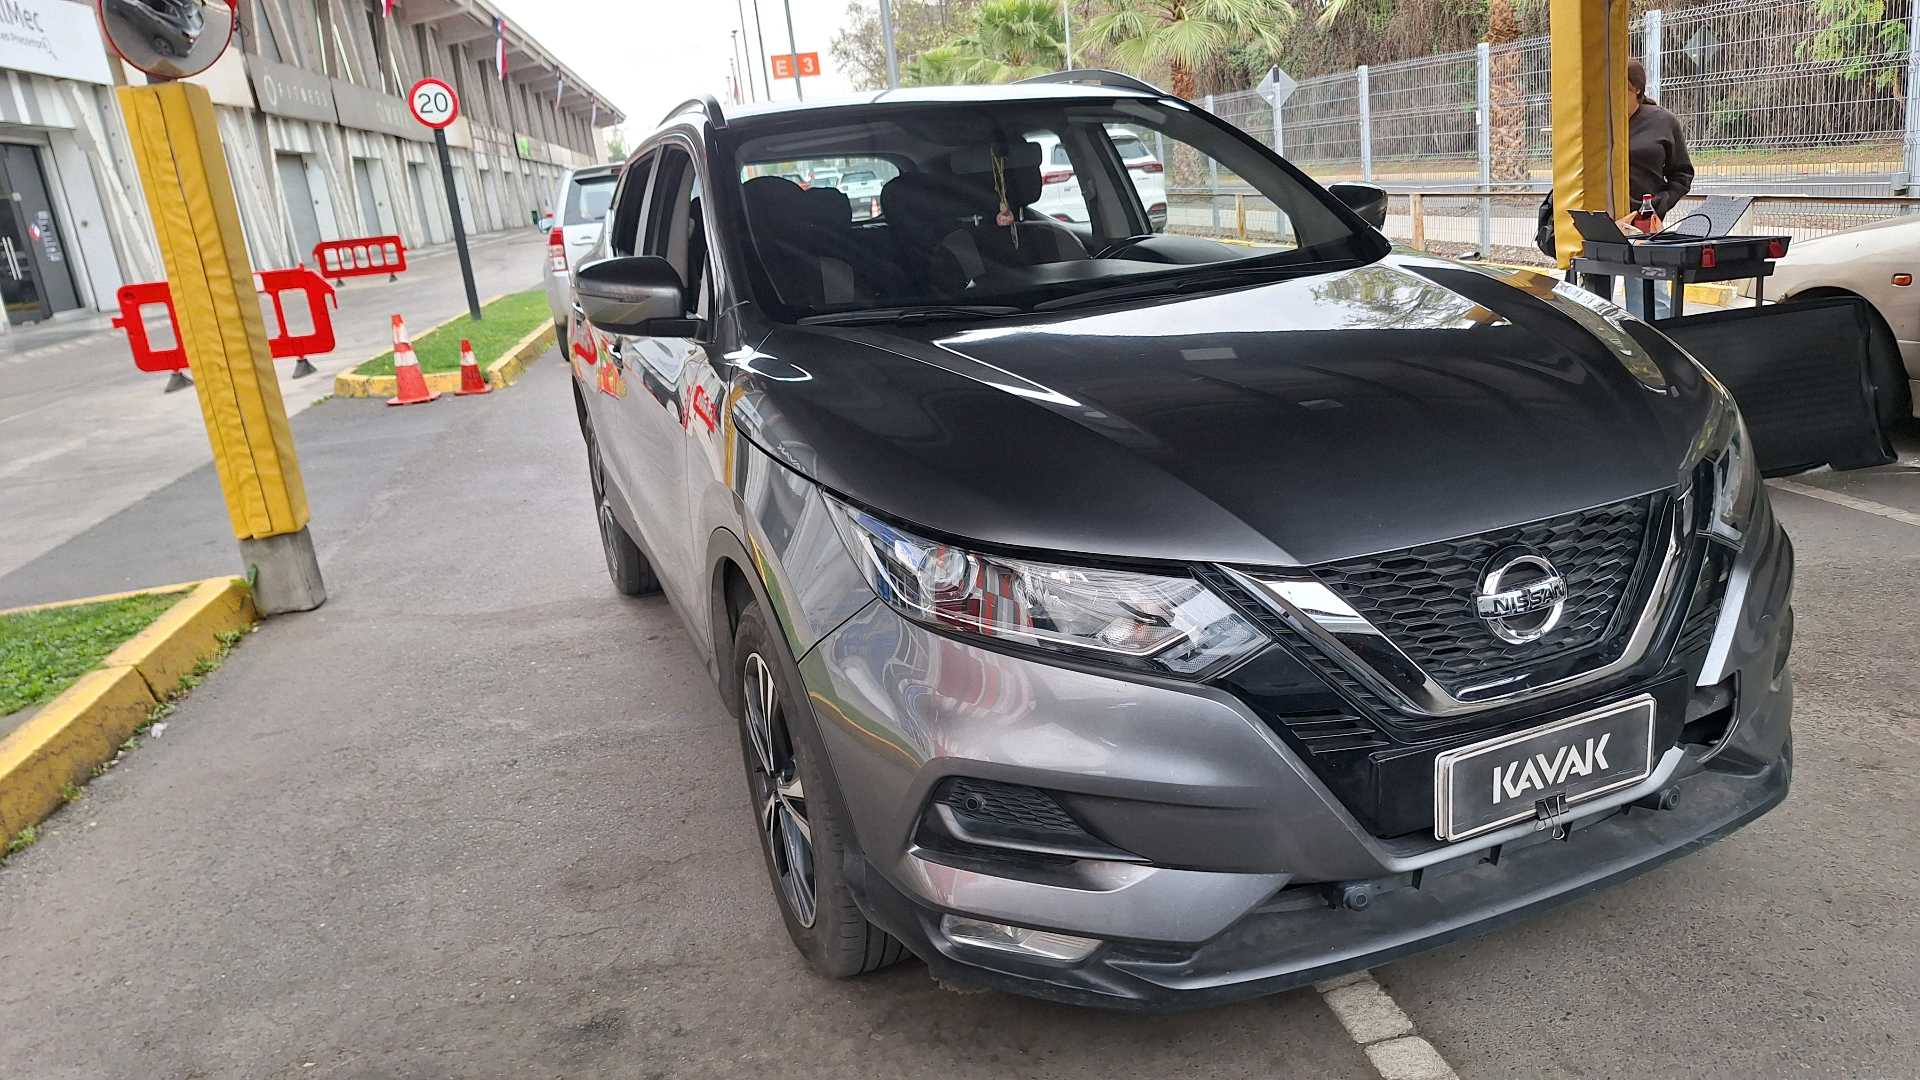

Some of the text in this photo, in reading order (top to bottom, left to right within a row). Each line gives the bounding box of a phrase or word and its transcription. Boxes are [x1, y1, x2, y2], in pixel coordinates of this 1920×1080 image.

[775, 57, 815, 76] E 3
[418, 92, 449, 114] 20
[1493, 581, 1564, 613] NISSAN
[1492, 732, 1611, 805] KAVAK
